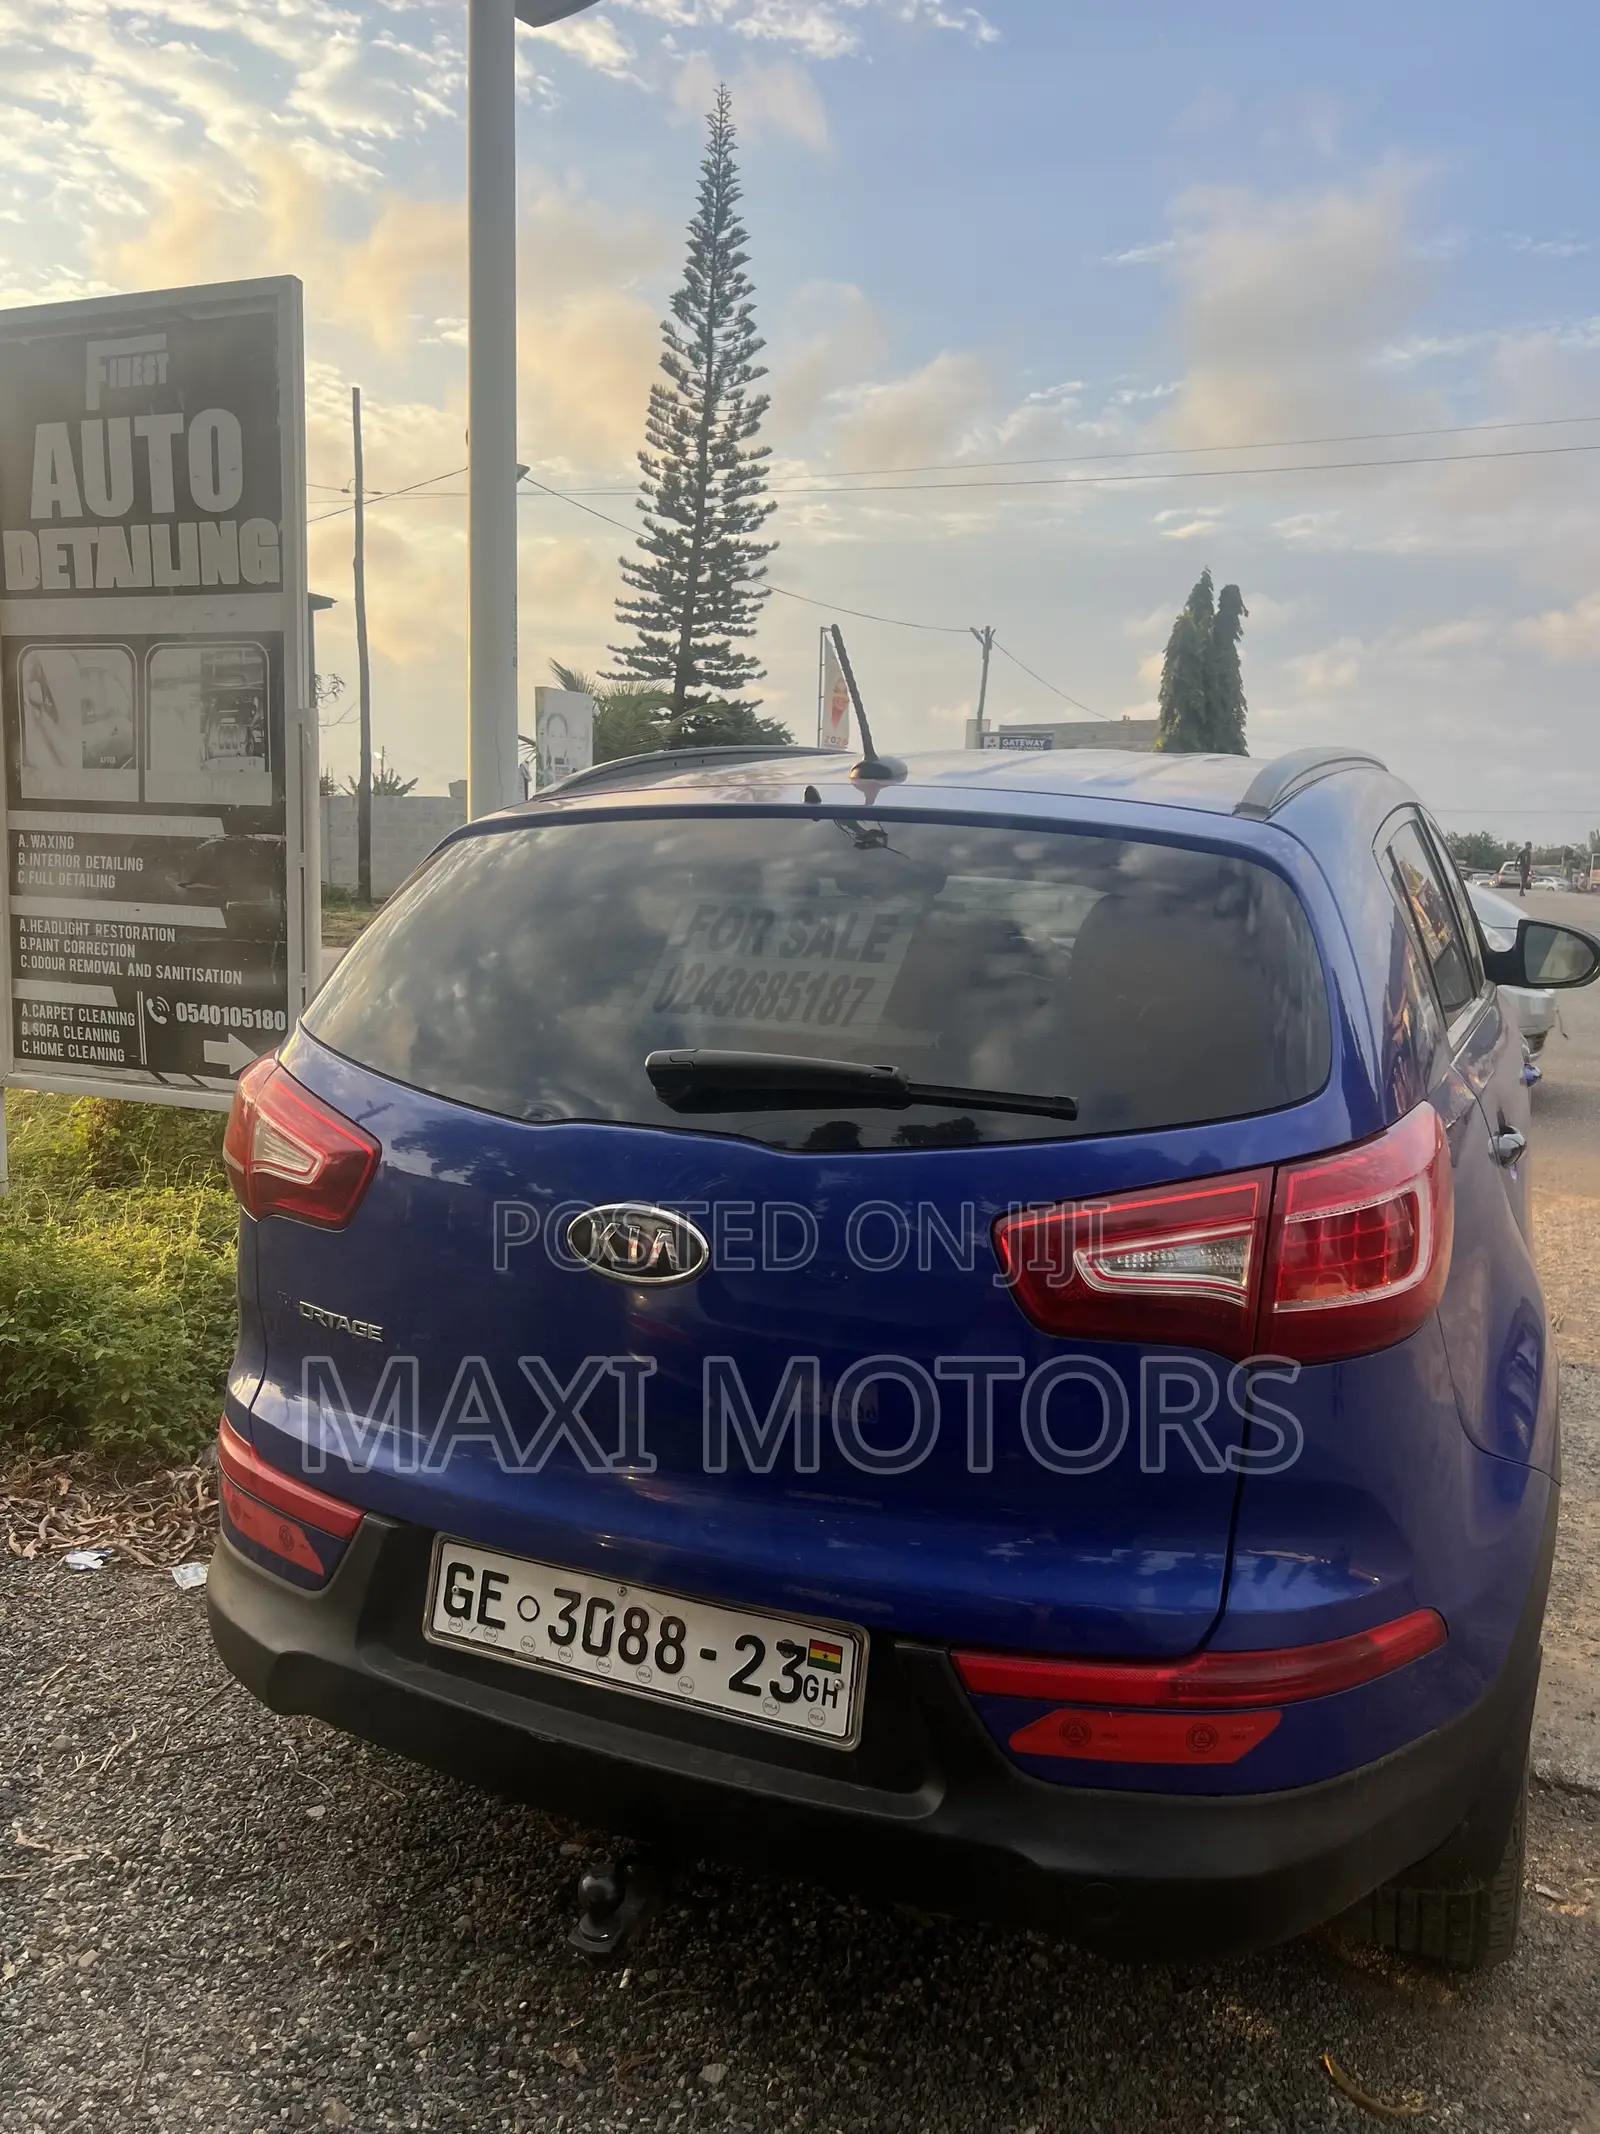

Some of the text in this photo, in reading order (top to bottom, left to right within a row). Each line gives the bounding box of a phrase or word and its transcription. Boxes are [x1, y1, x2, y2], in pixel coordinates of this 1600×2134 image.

[30, 408, 243, 519] AUTO
[2, 517, 281, 591] DETAILING
[1002, 738, 1046, 747] GATEWAY
[30, 834, 75, 850] WAXING
[85, 855, 144, 872] DETAILING
[58, 872, 116, 889] DETAILING
[95, 924, 176, 943] RESTORATION
[681, 904, 899, 963] FOR SALE
[63, 940, 136, 959] CORRECTION
[69, 958, 124, 977] REMOVAL
[127, 962, 152, 978] AND
[156, 964, 243, 986] SANITISATION
[652, 962, 876, 1028] 0243685187
[78, 1008, 136, 1027] CLEANING
[175, 1002, 287, 1032] 0540105180
[63, 1025, 121, 1044] CLEANING
[68, 1043, 126, 1063] CLEANING
[590, 1219, 679, 1271] KIA
[443, 1562, 509, 1630] GE
[803, 1674, 839, 1709] GH
